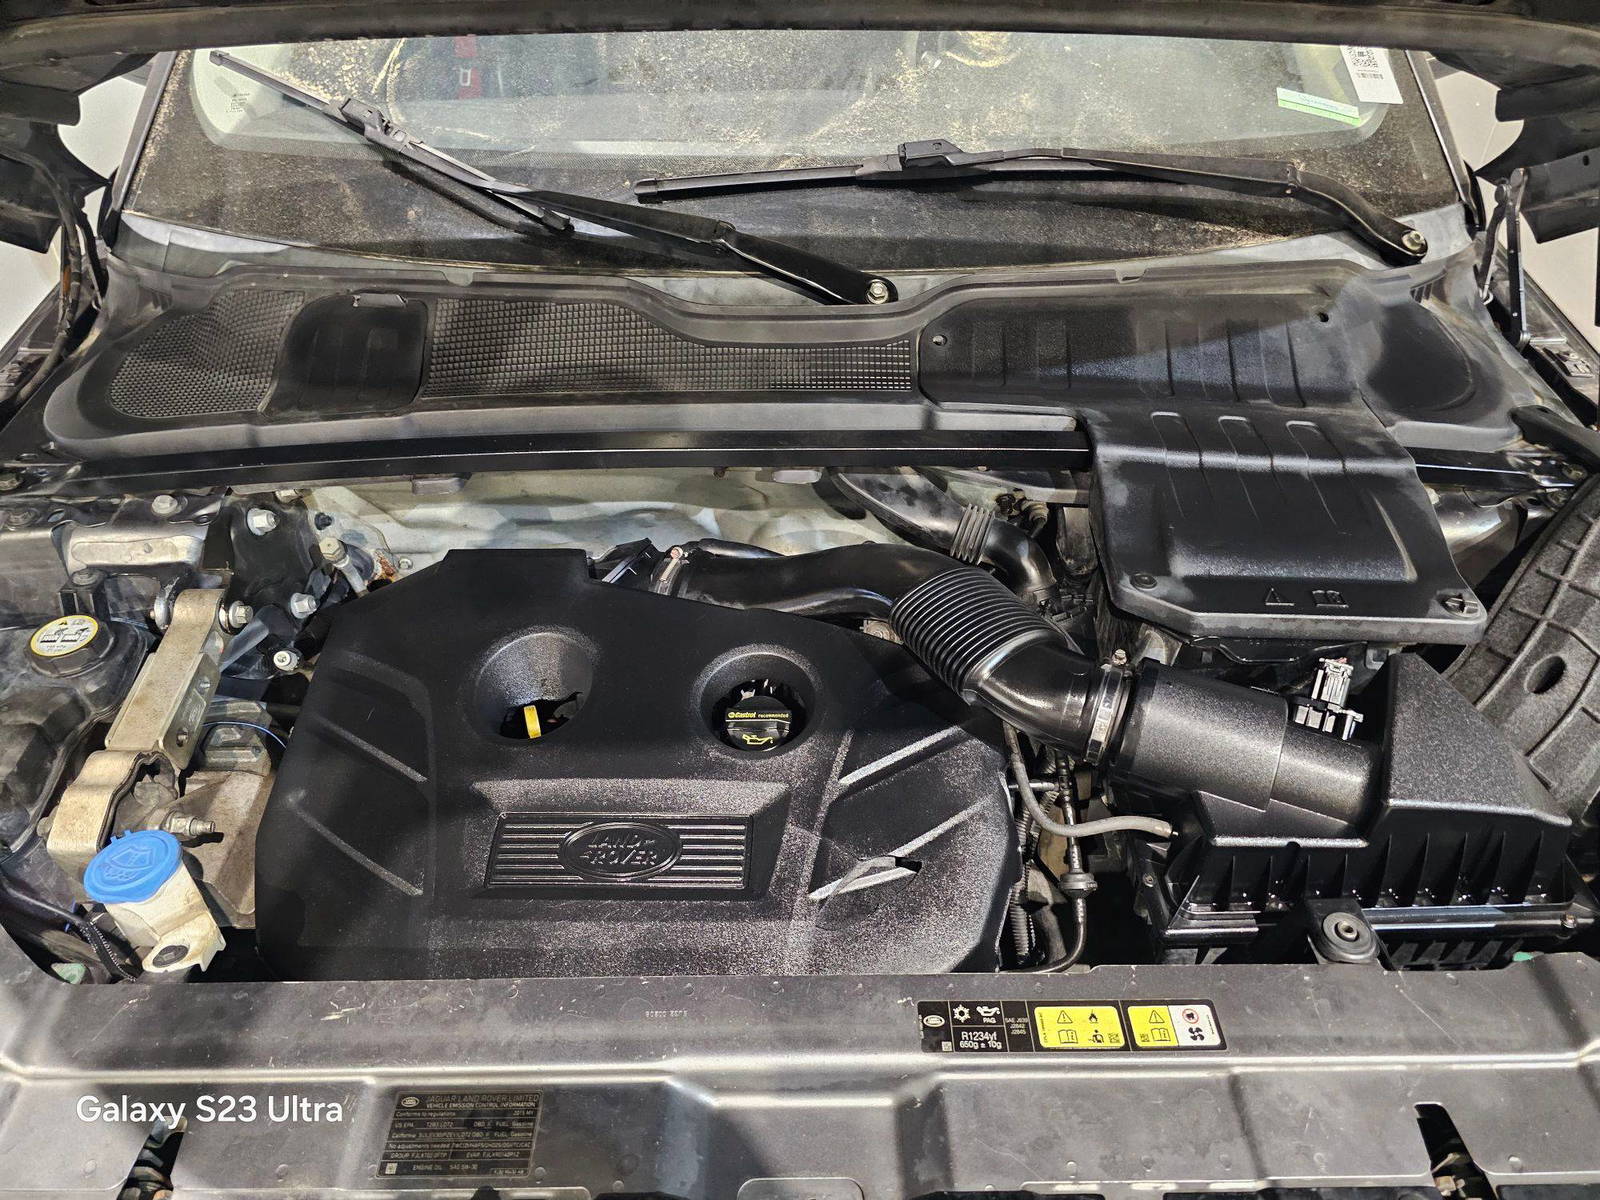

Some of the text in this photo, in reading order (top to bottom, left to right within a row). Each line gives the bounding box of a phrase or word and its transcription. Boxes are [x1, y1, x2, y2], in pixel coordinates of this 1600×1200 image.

[734, 711, 757, 719] Castrol
[961, 1031, 998, 1041] R1234yf
[959, 1040, 979, 1050] 650g
[987, 1040, 1003, 1050] 10g
[425, 1094, 457, 1103] JAGUAR
[459, 1094, 480, 1102] LAND
[482, 1094, 506, 1102] ROVER
[507, 1093, 539, 1102] LIMITED
